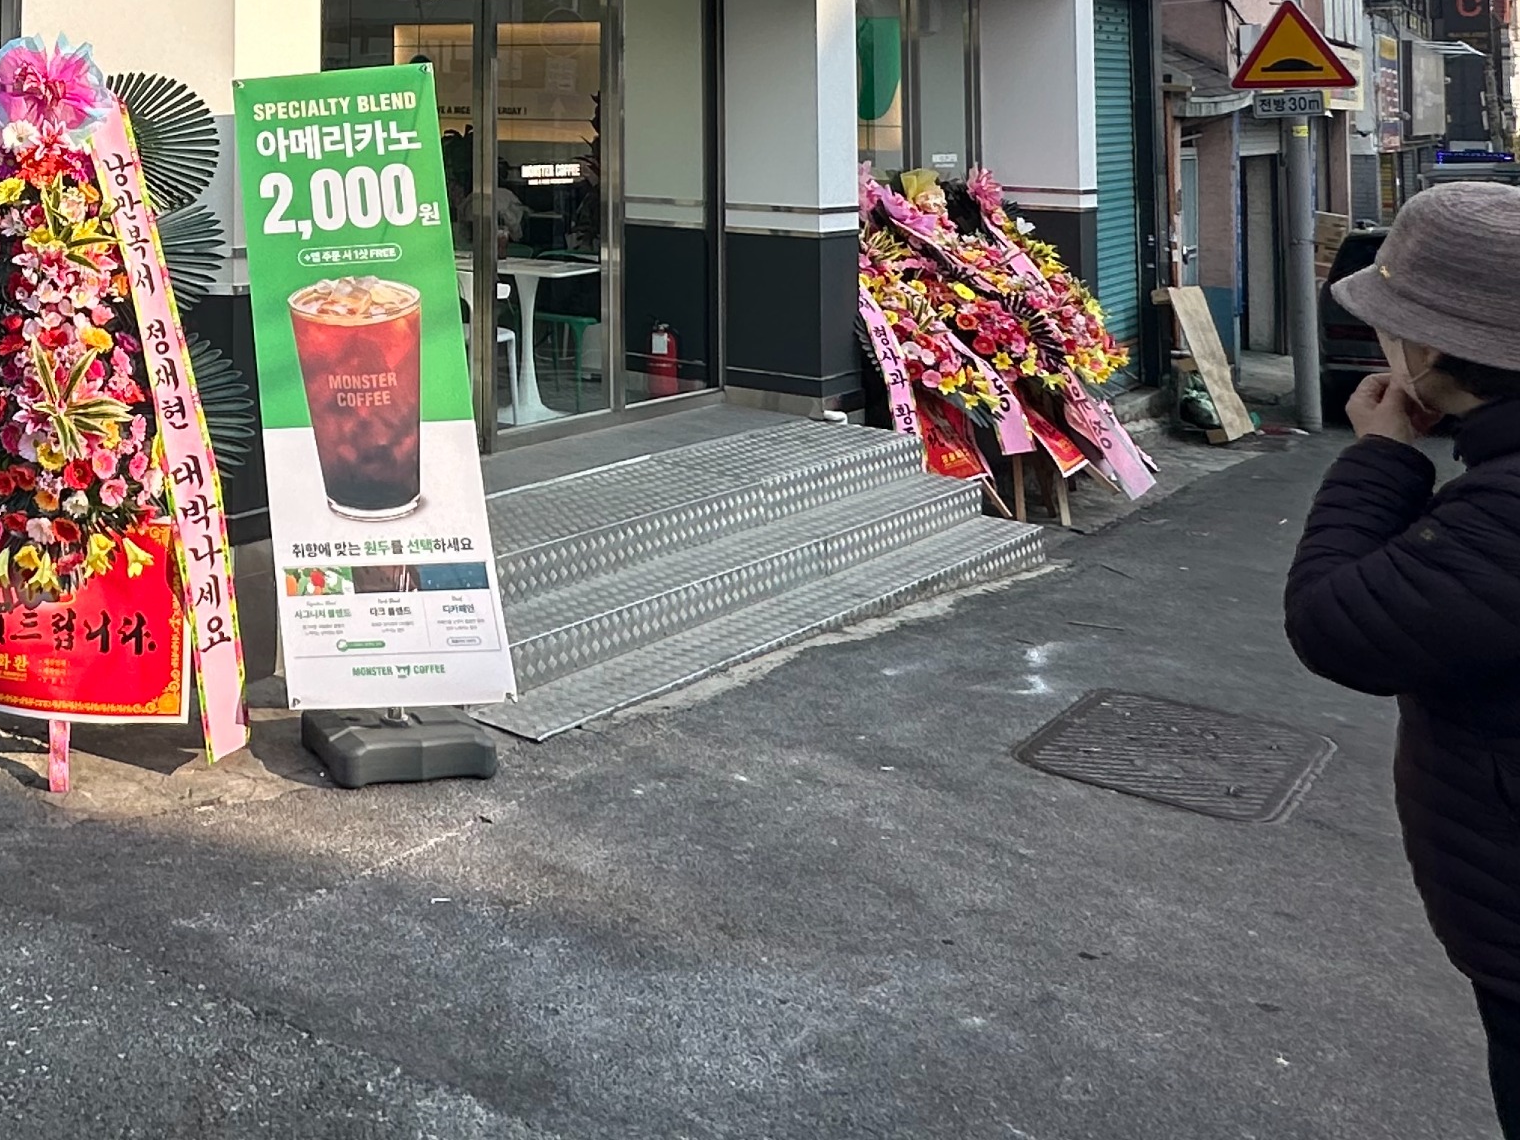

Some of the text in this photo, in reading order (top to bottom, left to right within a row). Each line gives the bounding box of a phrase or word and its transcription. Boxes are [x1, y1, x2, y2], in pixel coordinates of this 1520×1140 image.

[253, 90, 417, 121] SPECIALTY BLEND
[256, 119, 422, 162] 아메리카노
[259, 162, 442, 240] 2,000원
[369, 247, 397, 258] FREE
[327, 371, 398, 390] MONSTER
[103, 152, 232, 654] 낭만복서 정재현 대박나세요
[336, 390, 392, 407] COFFEE
[292, 537, 475, 559] 취향에 맞는 원두를 선택하세요
[369, 607, 386, 617] 다크
[352, 664, 446, 678] MONSTER COFFEE
